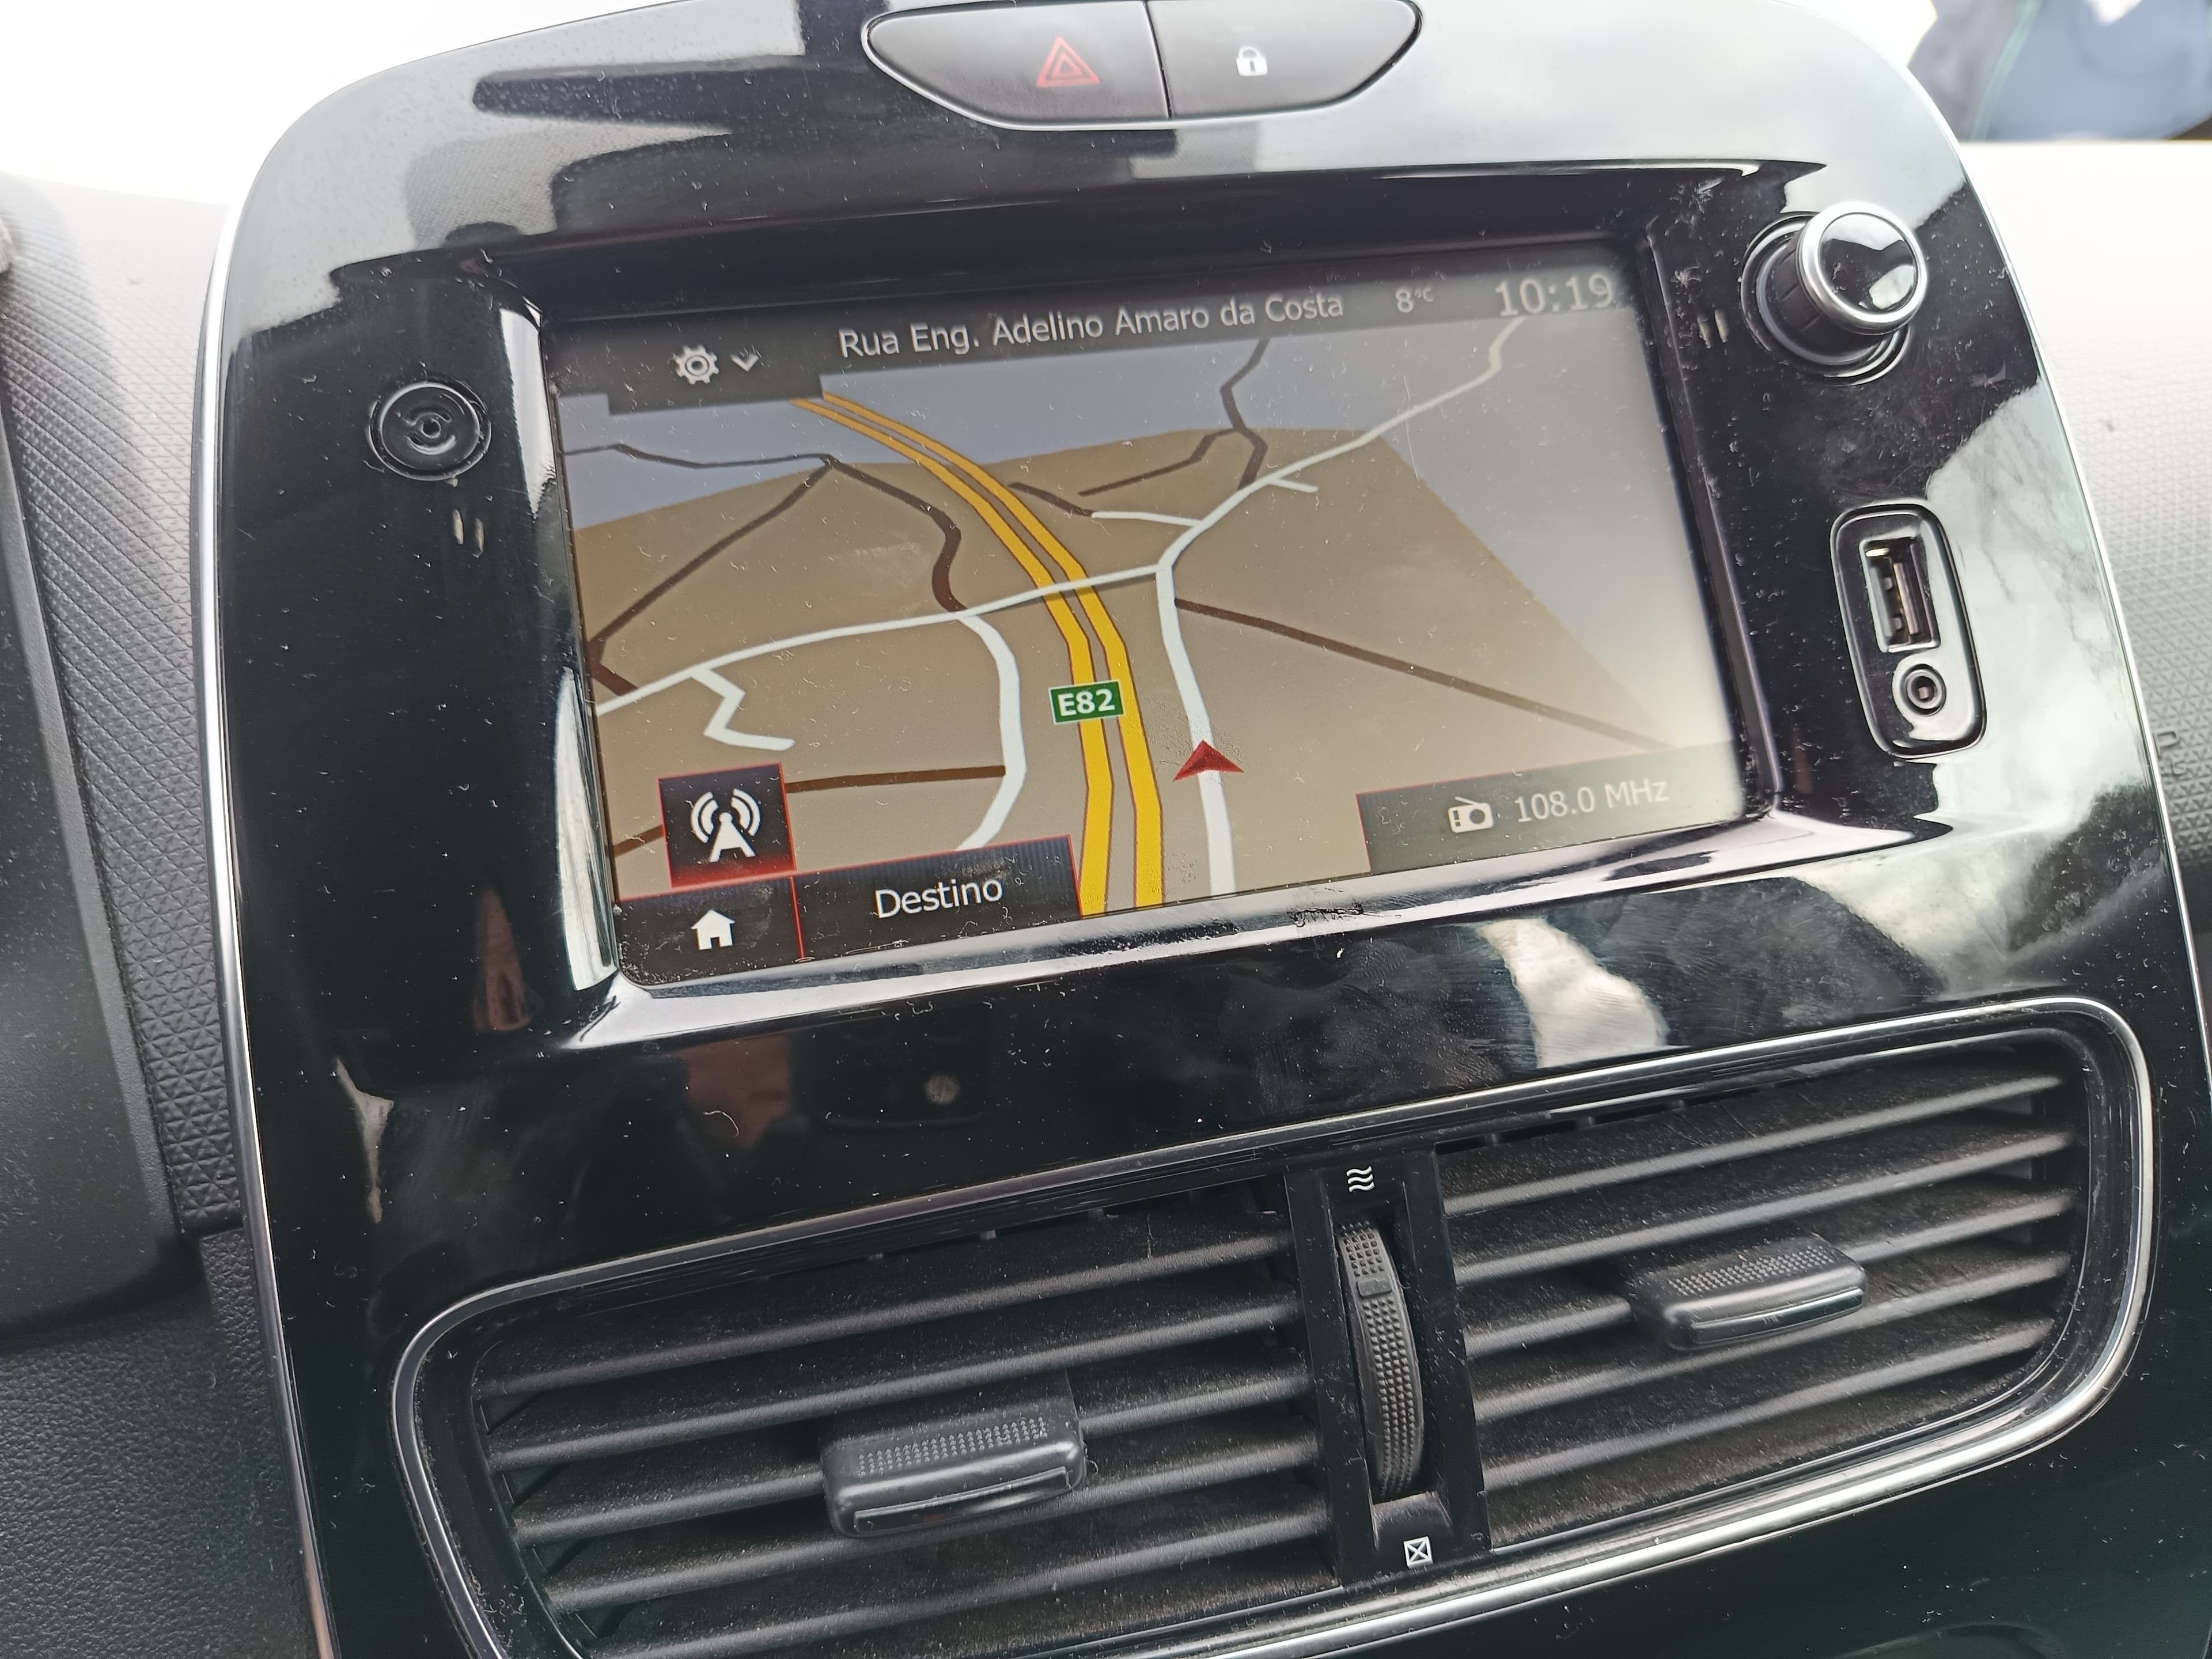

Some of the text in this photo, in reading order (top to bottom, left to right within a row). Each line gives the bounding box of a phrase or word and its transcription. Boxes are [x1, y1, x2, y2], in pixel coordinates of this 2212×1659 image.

[1496, 272, 1613, 316] 10:19
[839, 292, 1343, 359] Rua Eng. Adelino Amaro da Costa
[1057, 688, 1116, 717] E82
[1514, 778, 1669, 823] 108.0 MHz
[875, 877, 1003, 919] Destino
